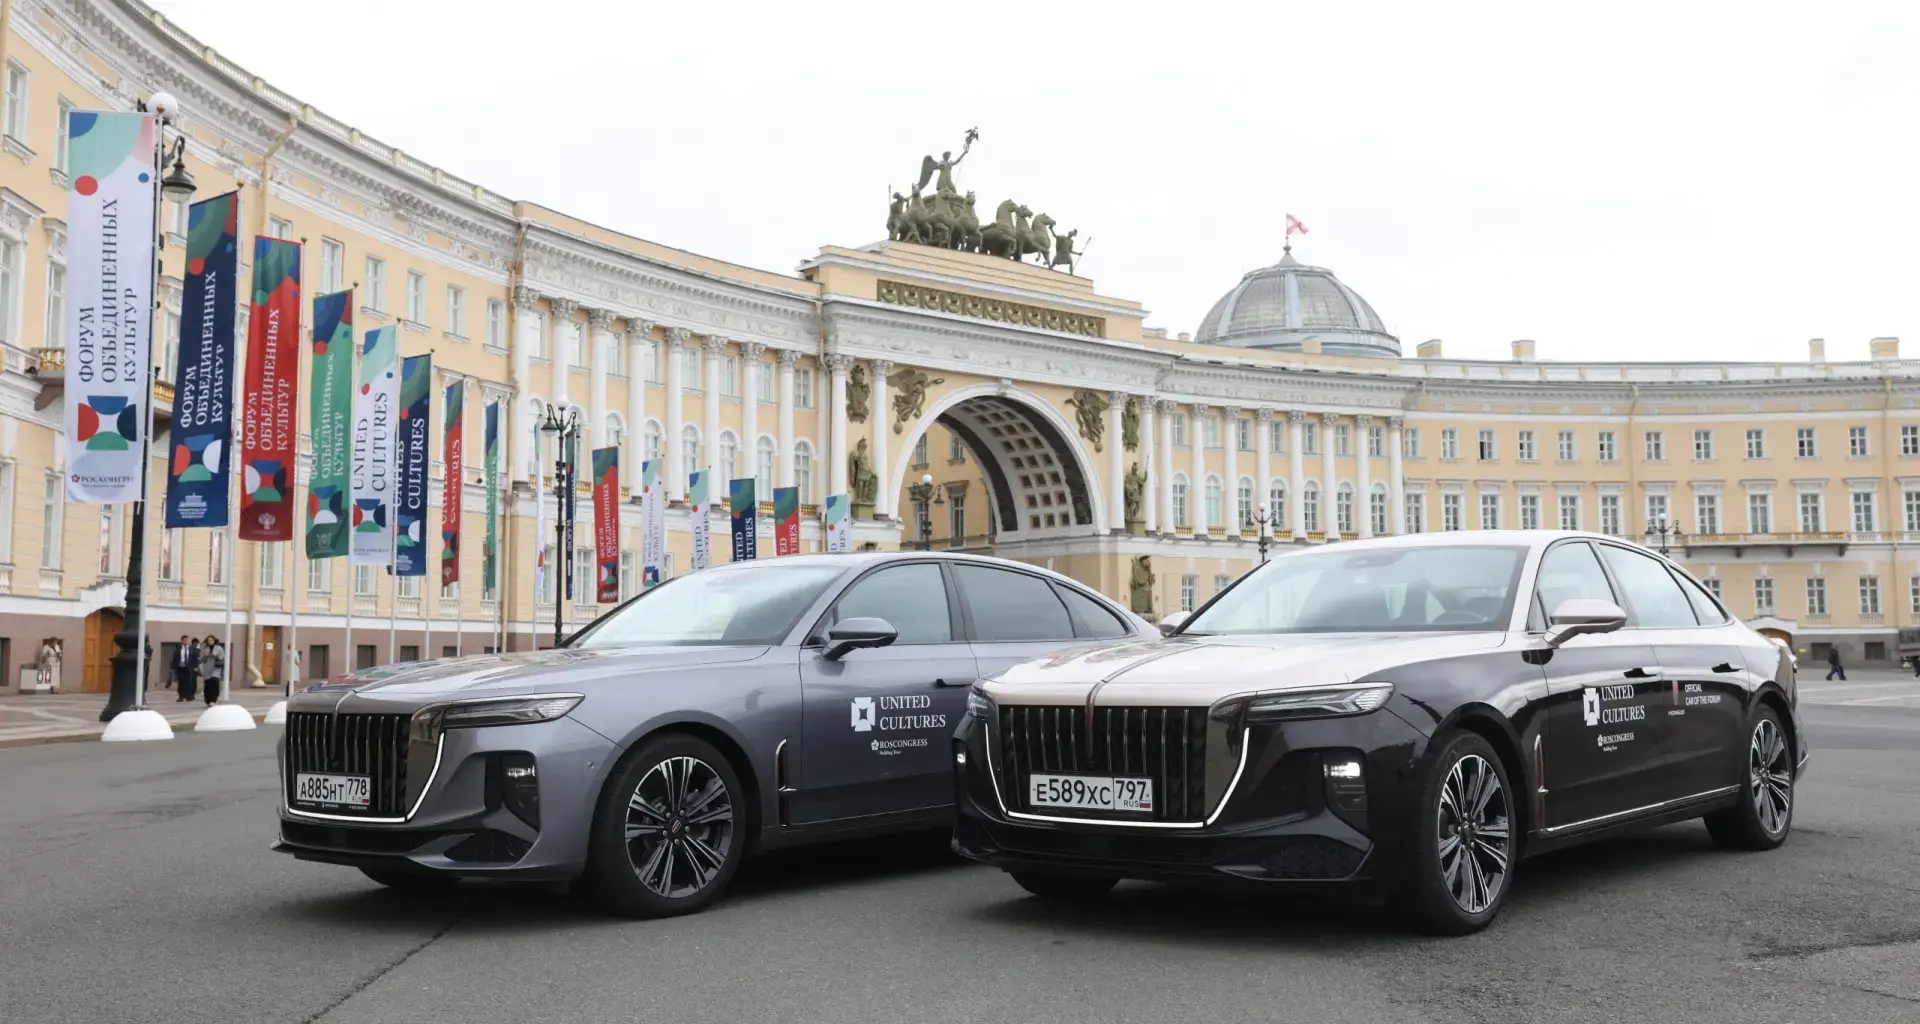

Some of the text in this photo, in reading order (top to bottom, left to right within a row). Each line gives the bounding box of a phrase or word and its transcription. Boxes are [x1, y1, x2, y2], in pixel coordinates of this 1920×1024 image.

[101, 198, 120, 384] ОБЪЕДИНЕННЫХ
[78, 306, 94, 383] ФОРУМ
[124, 288, 138, 383] КУЛЬТУР
[195, 270, 216, 426] ОБЪЕДИНЕННЫХ
[180, 365, 197, 428] ФОРУМ
[211, 343, 224, 424] КУЛЬТУР
[260, 308, 280, 451] ОБЪЕДИНЕННЫХ
[245, 392, 258, 451] ФОРУМ
[277, 378, 290, 451] КУЛЬТУР
[321, 353, 334, 479] ОБЪЕДИНЕННЫХ
[333, 411, 344, 476] КУЛЬТУР
[372, 392, 388, 492] CULTURES
[353, 418, 368, 490] UNITED
[407, 418, 424, 510] CULTURES
[735, 531, 744, 561] ITED
[745, 517, 755, 560] LTURES
[879, 694, 931, 710] UNITED
[1601, 684, 1634, 701] UNITED
[1602, 704, 1645, 724] CULTURES
[1685, 684, 1702, 692] OFFICIAL
[879, 714, 946, 731] CULTURES
[879, 738, 928, 749] ROSCONGRESS
[347, 779, 367, 796] 778
[1115, 780, 1147, 801] 797
[1123, 800, 1139, 808] RUS
